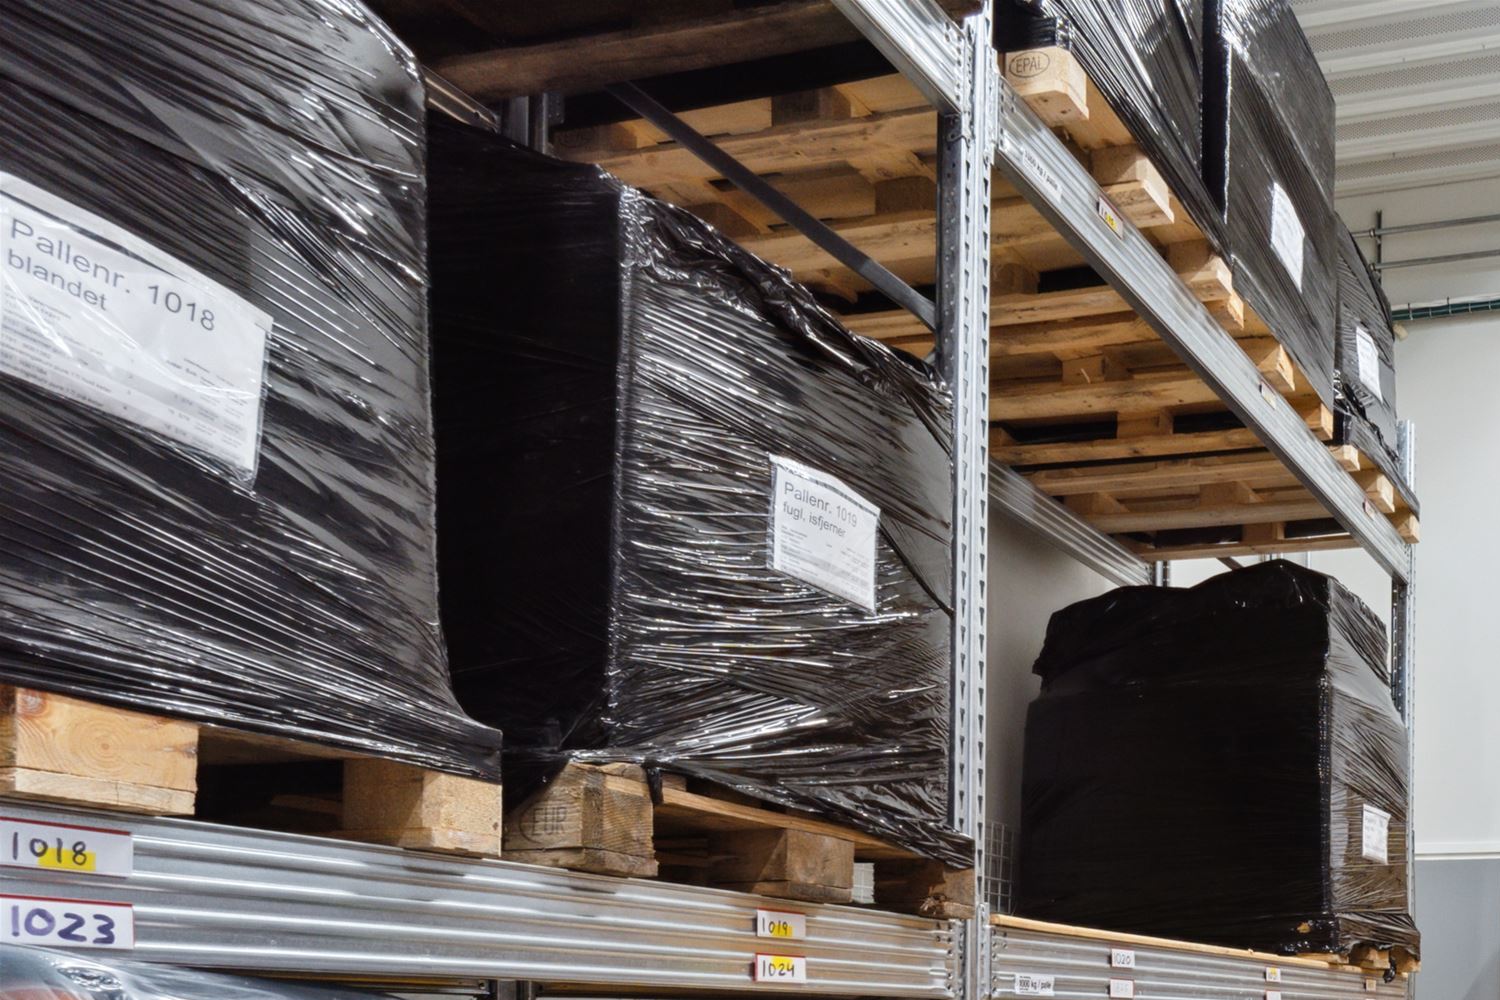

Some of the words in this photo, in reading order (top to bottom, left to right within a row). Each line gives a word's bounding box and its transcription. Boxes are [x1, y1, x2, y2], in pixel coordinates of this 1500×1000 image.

[1015, 54, 1043, 74] EPAL
[8, 248, 107, 311] blandet
[10, 218, 131, 294] Pallenr.
[148, 285, 215, 331] 1018
[784, 481, 832, 514] Pallenr.
[836, 505, 858, 527] 1019
[13, 832, 87, 866] 1018
[11, 905, 115, 945] 1023
[762, 917, 788, 936] 1019
[763, 959, 795, 977] 1024
